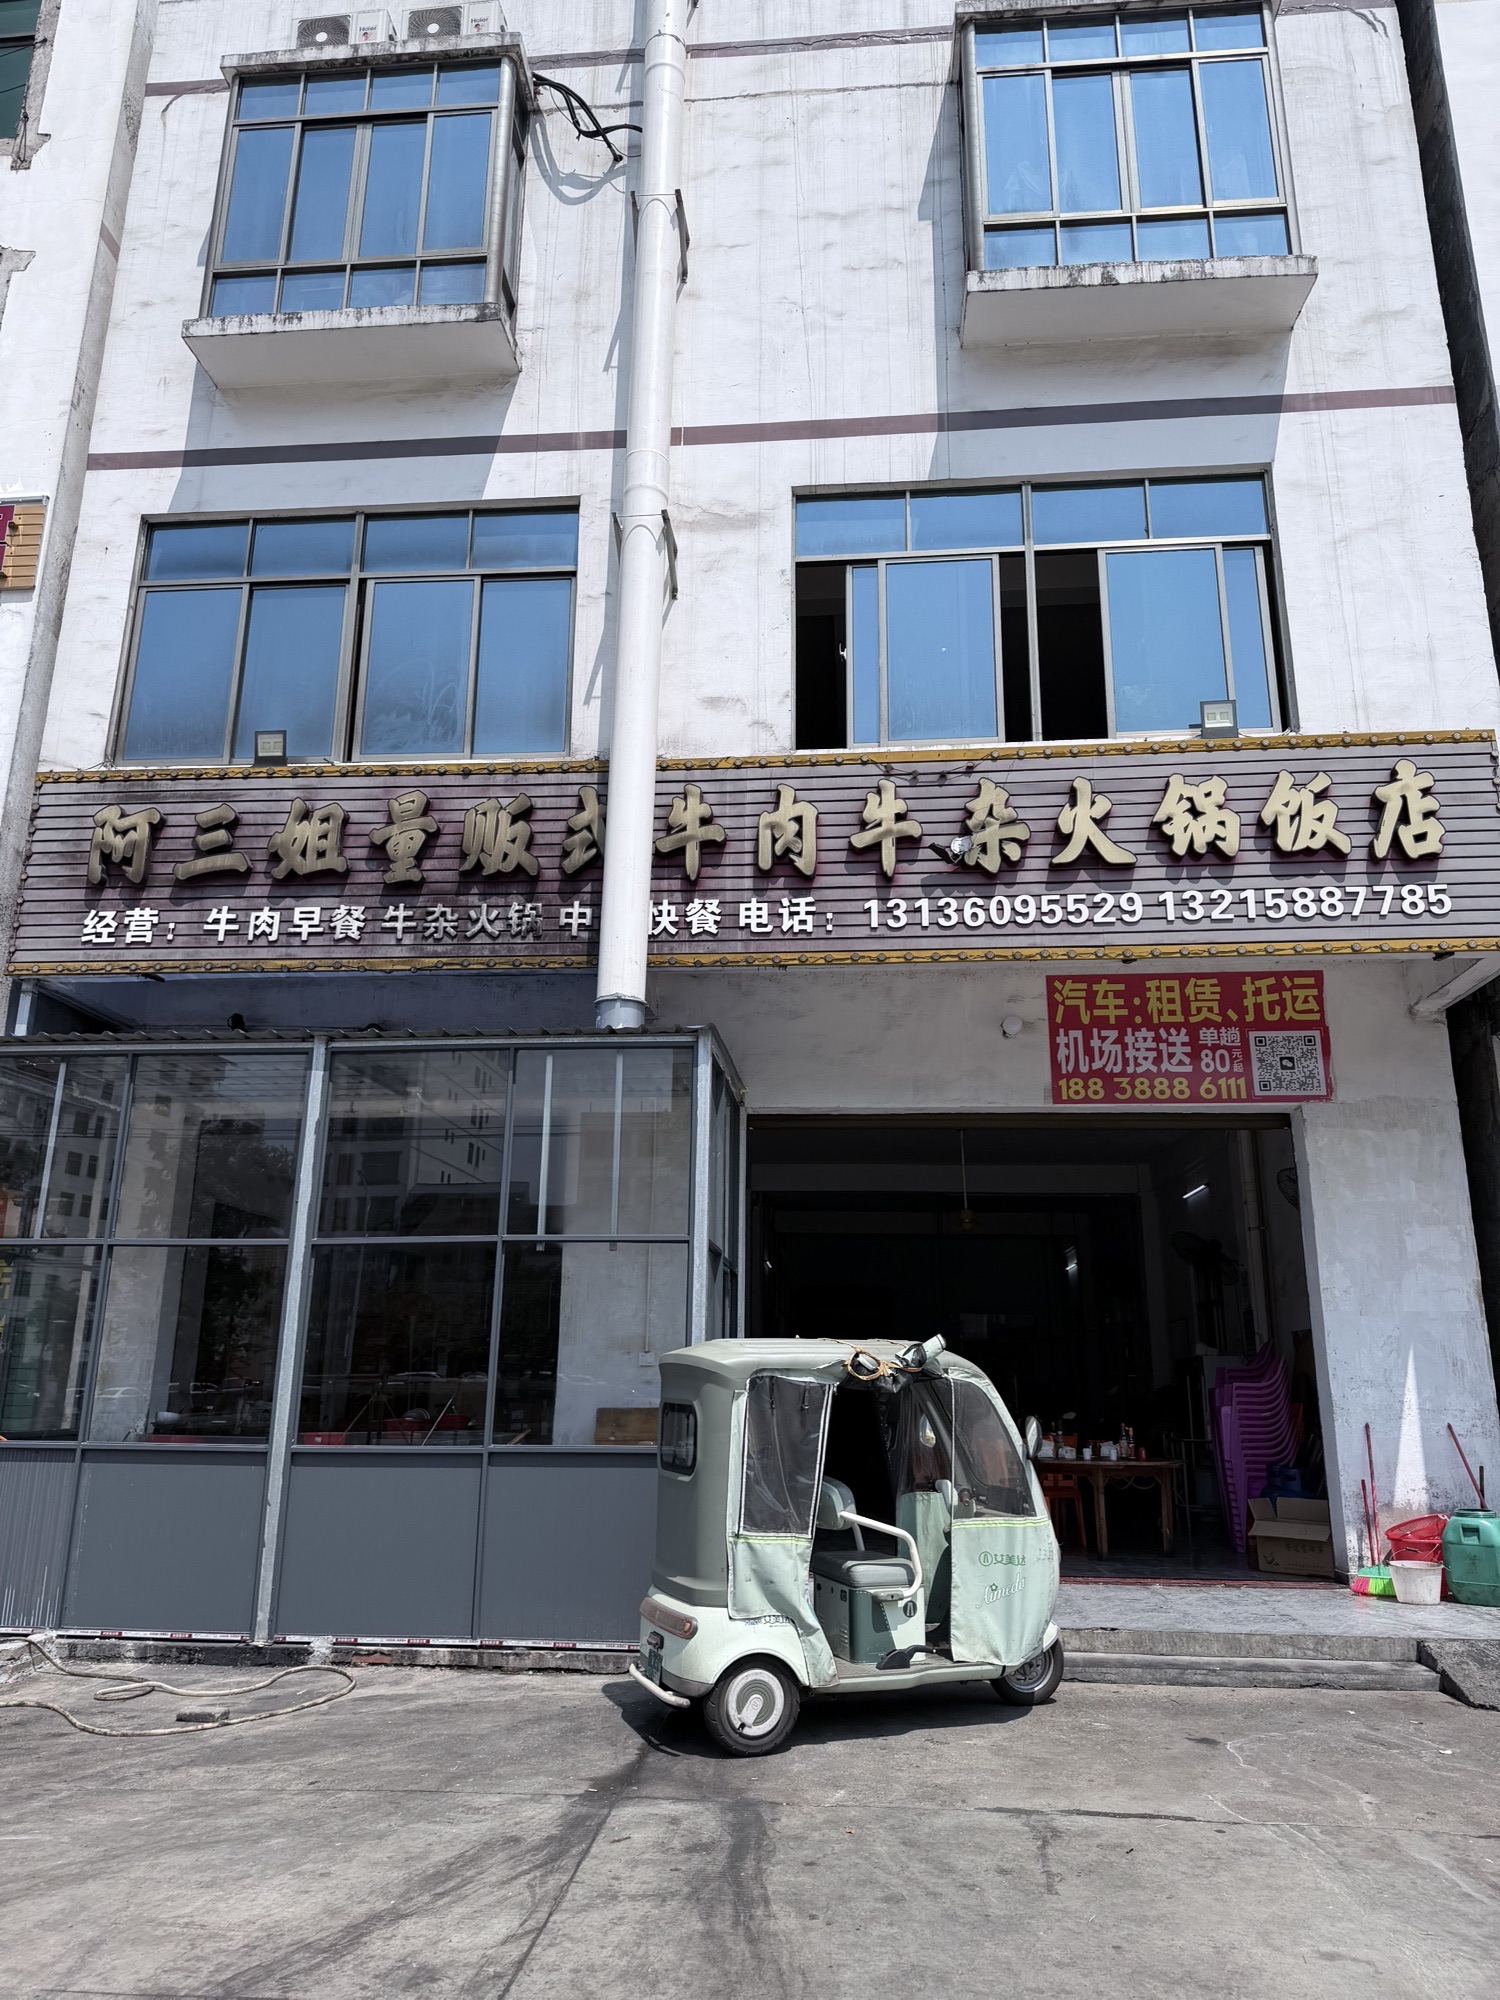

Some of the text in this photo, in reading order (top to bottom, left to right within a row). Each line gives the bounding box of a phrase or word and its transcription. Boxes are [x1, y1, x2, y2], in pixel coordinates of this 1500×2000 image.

[359, 25, 377, 33] Haier
[470, 16, 489, 24] Haier
[81, 884, 1452, 944] 经营： 牛肉早餐 牛杂火锅 中快餐 电话： 13136095529 13215887785
[1199, 1026, 1241, 1046] 单趟
[1056, 1027, 1193, 1074] 机场接送
[1200, 1049, 1230, 1073] 80
[1058, 1077, 1247, 1100] 188 3888 6111
